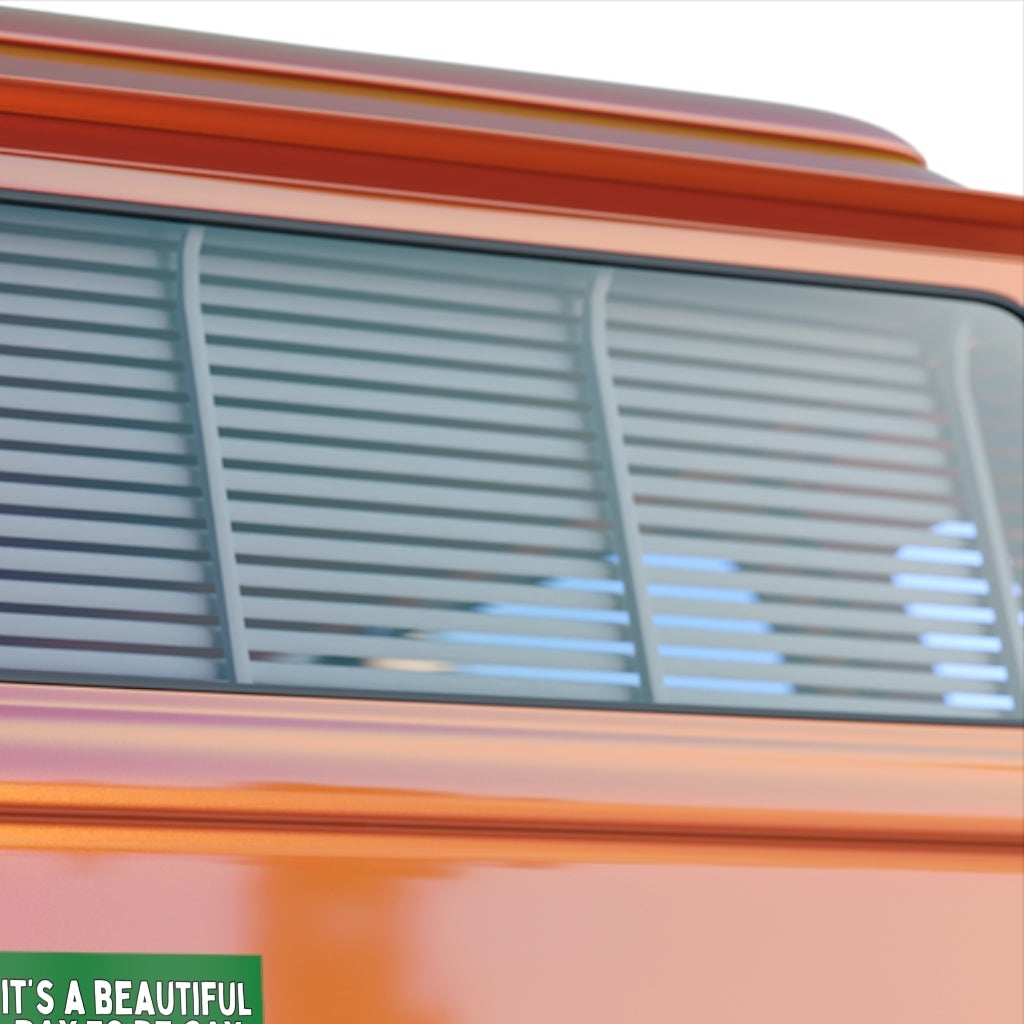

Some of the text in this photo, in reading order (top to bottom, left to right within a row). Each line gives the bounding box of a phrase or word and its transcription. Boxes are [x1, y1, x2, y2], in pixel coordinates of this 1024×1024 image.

[1, 979, 252, 1017] IT'S A BEAUTIFUL
